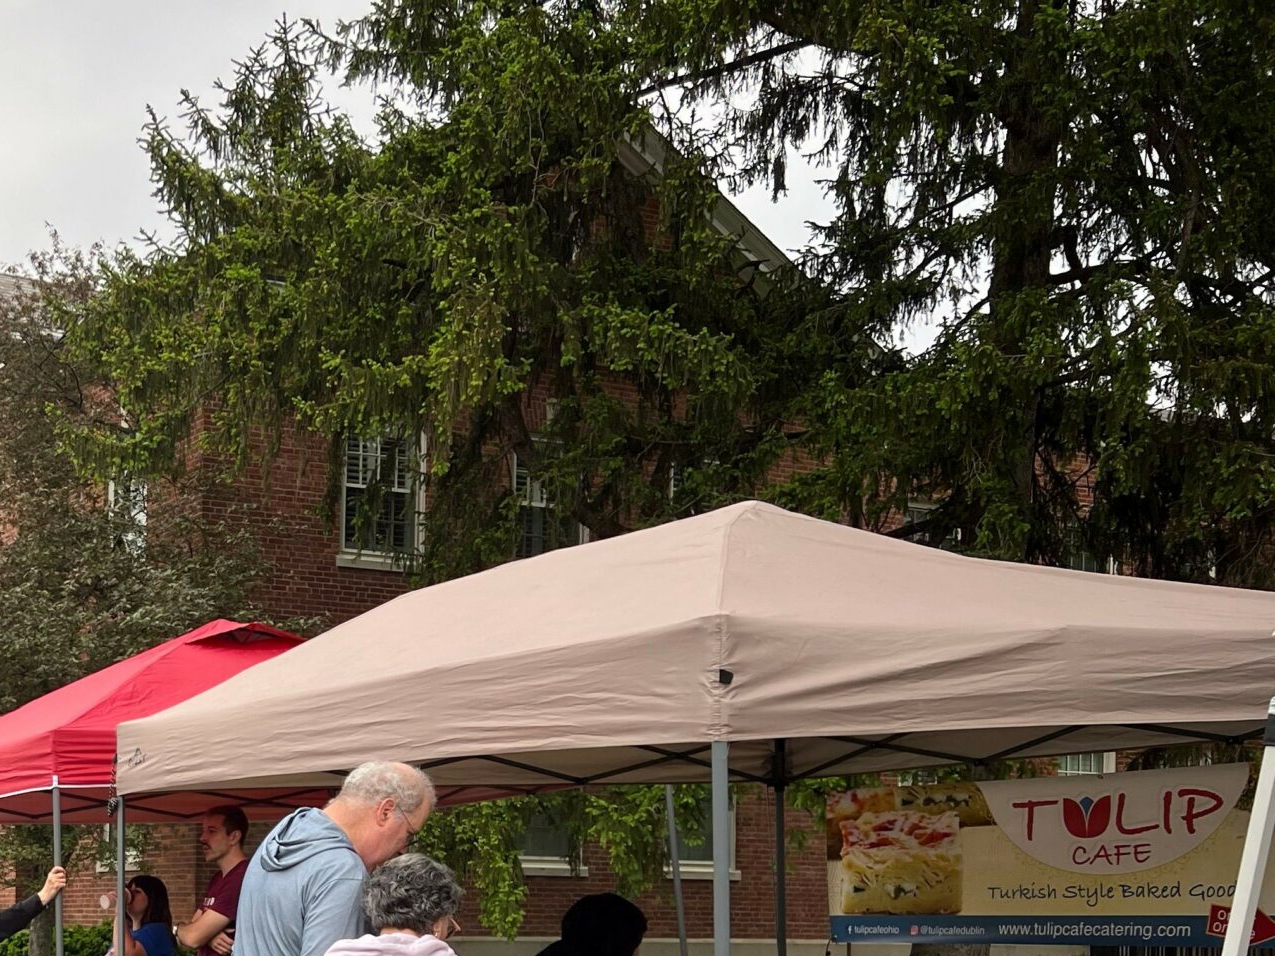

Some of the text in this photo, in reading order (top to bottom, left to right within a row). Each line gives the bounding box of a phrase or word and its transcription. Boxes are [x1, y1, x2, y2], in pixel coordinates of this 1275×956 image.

[1012, 788, 1224, 841] TULIP
[1071, 843, 1151, 866] CAFE
[987, 881, 1057, 899] Turkish
[1062, 883, 1115, 907] Style
[1118, 880, 1182, 899] Baked
[853, 924, 900, 935] tulipcafeohio
[998, 921, 1191, 940] www.tulipcafecatering.com
